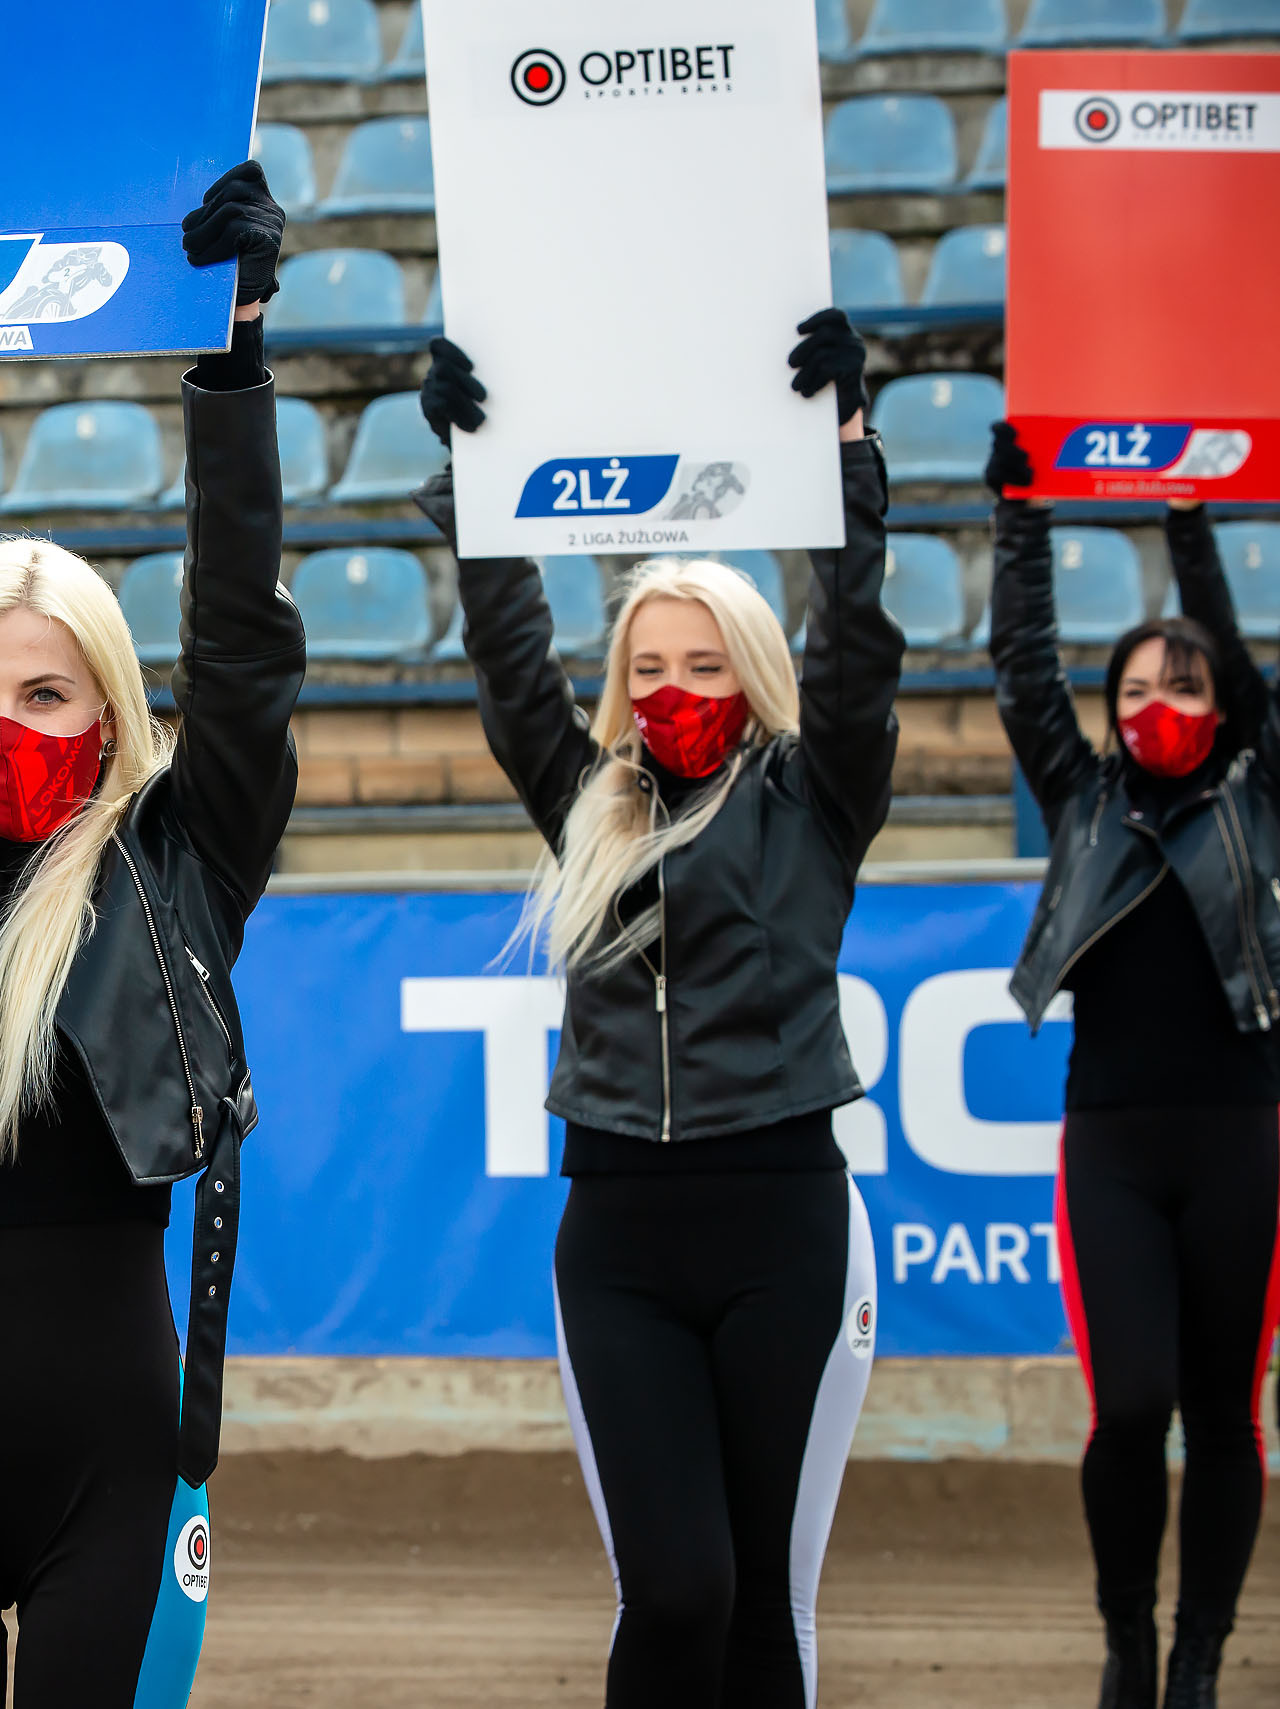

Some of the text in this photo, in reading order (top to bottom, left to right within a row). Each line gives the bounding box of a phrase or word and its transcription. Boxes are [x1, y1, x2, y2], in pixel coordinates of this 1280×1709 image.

[579, 44, 735, 86] OPTIBET
[1131, 101, 1257, 131] OPTIBET
[1084, 423, 1152, 466] 2LŻ
[552, 458, 631, 511] 2LŻ
[583, 532, 614, 545] LIGA
[618, 528, 689, 544] ŻUŻLOWA
[401, 968, 1074, 1178] TO
